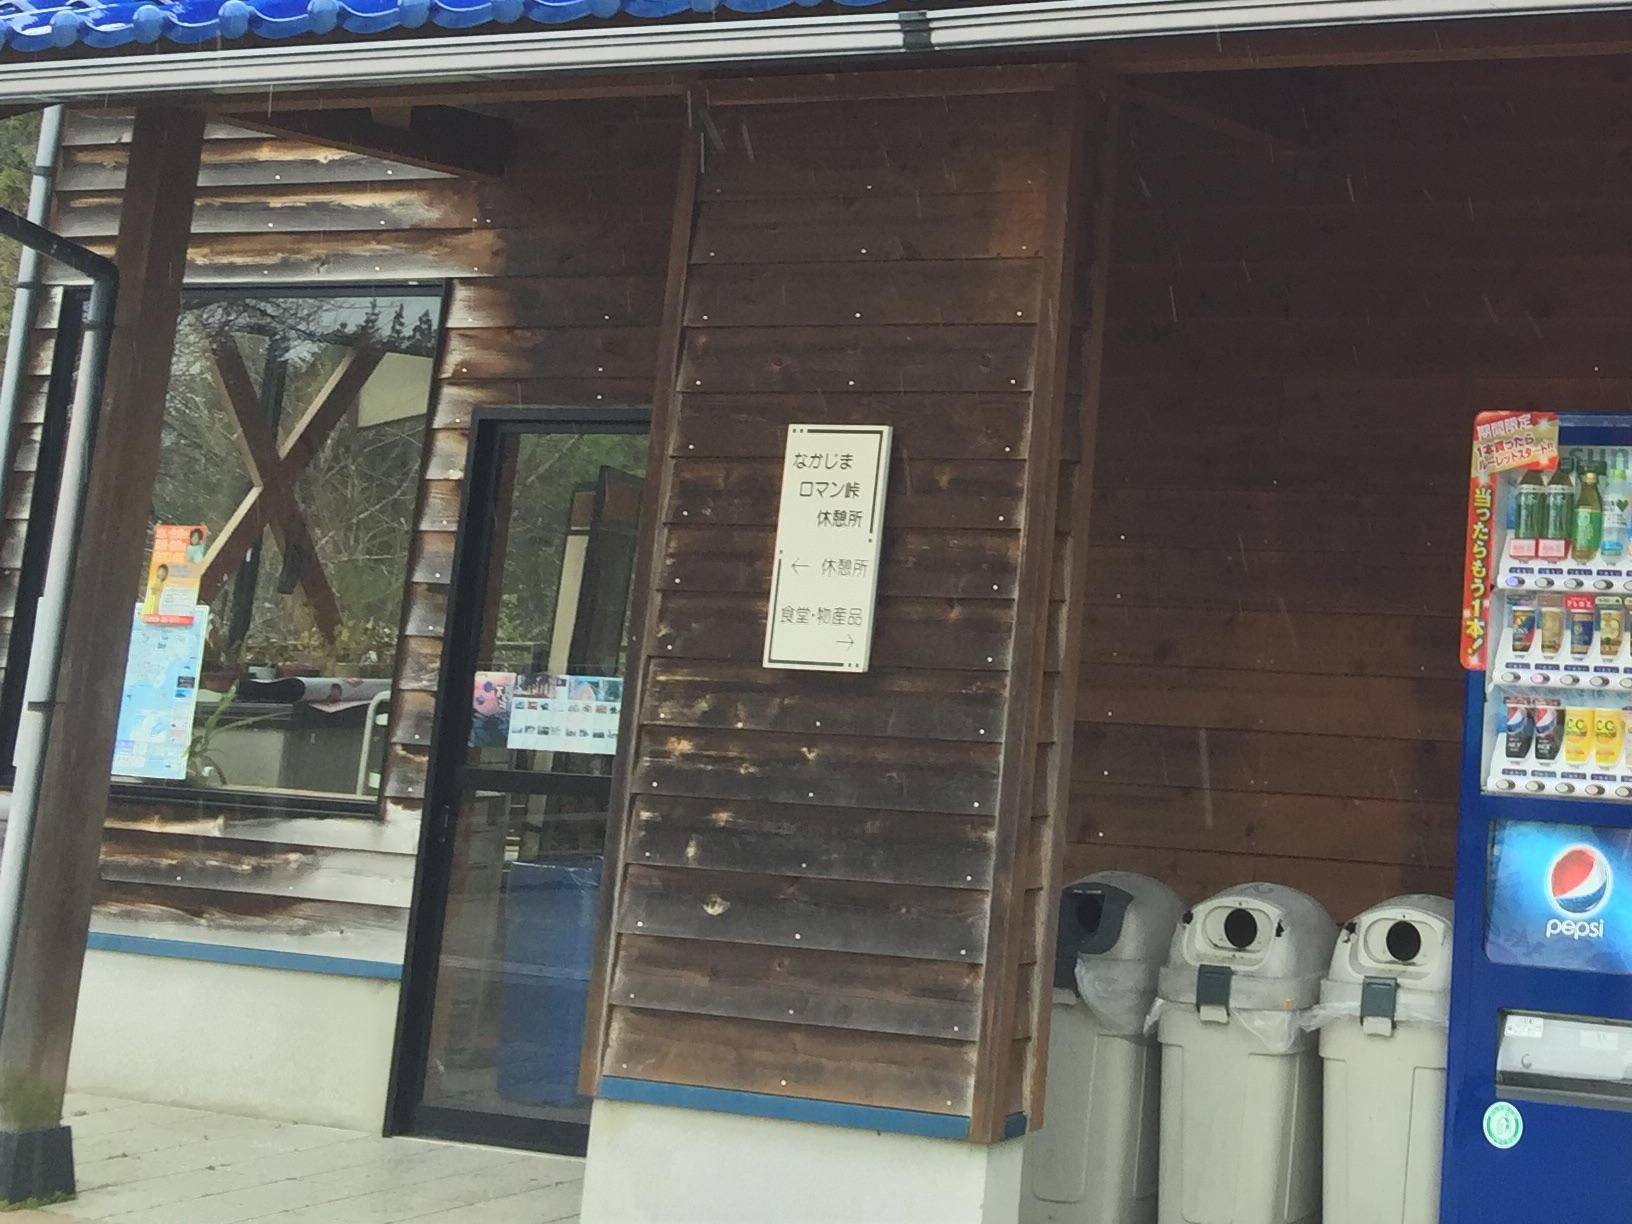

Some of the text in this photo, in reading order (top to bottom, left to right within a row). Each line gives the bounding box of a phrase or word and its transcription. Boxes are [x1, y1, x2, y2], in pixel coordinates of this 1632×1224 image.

[793, 452, 854, 470] なかじま
[799, 481, 861, 499] ロマン峠
[816, 509, 864, 528] 休憩所
[820, 557, 869, 577] 休憩所
[1545, 918, 1605, 939] pepsi
